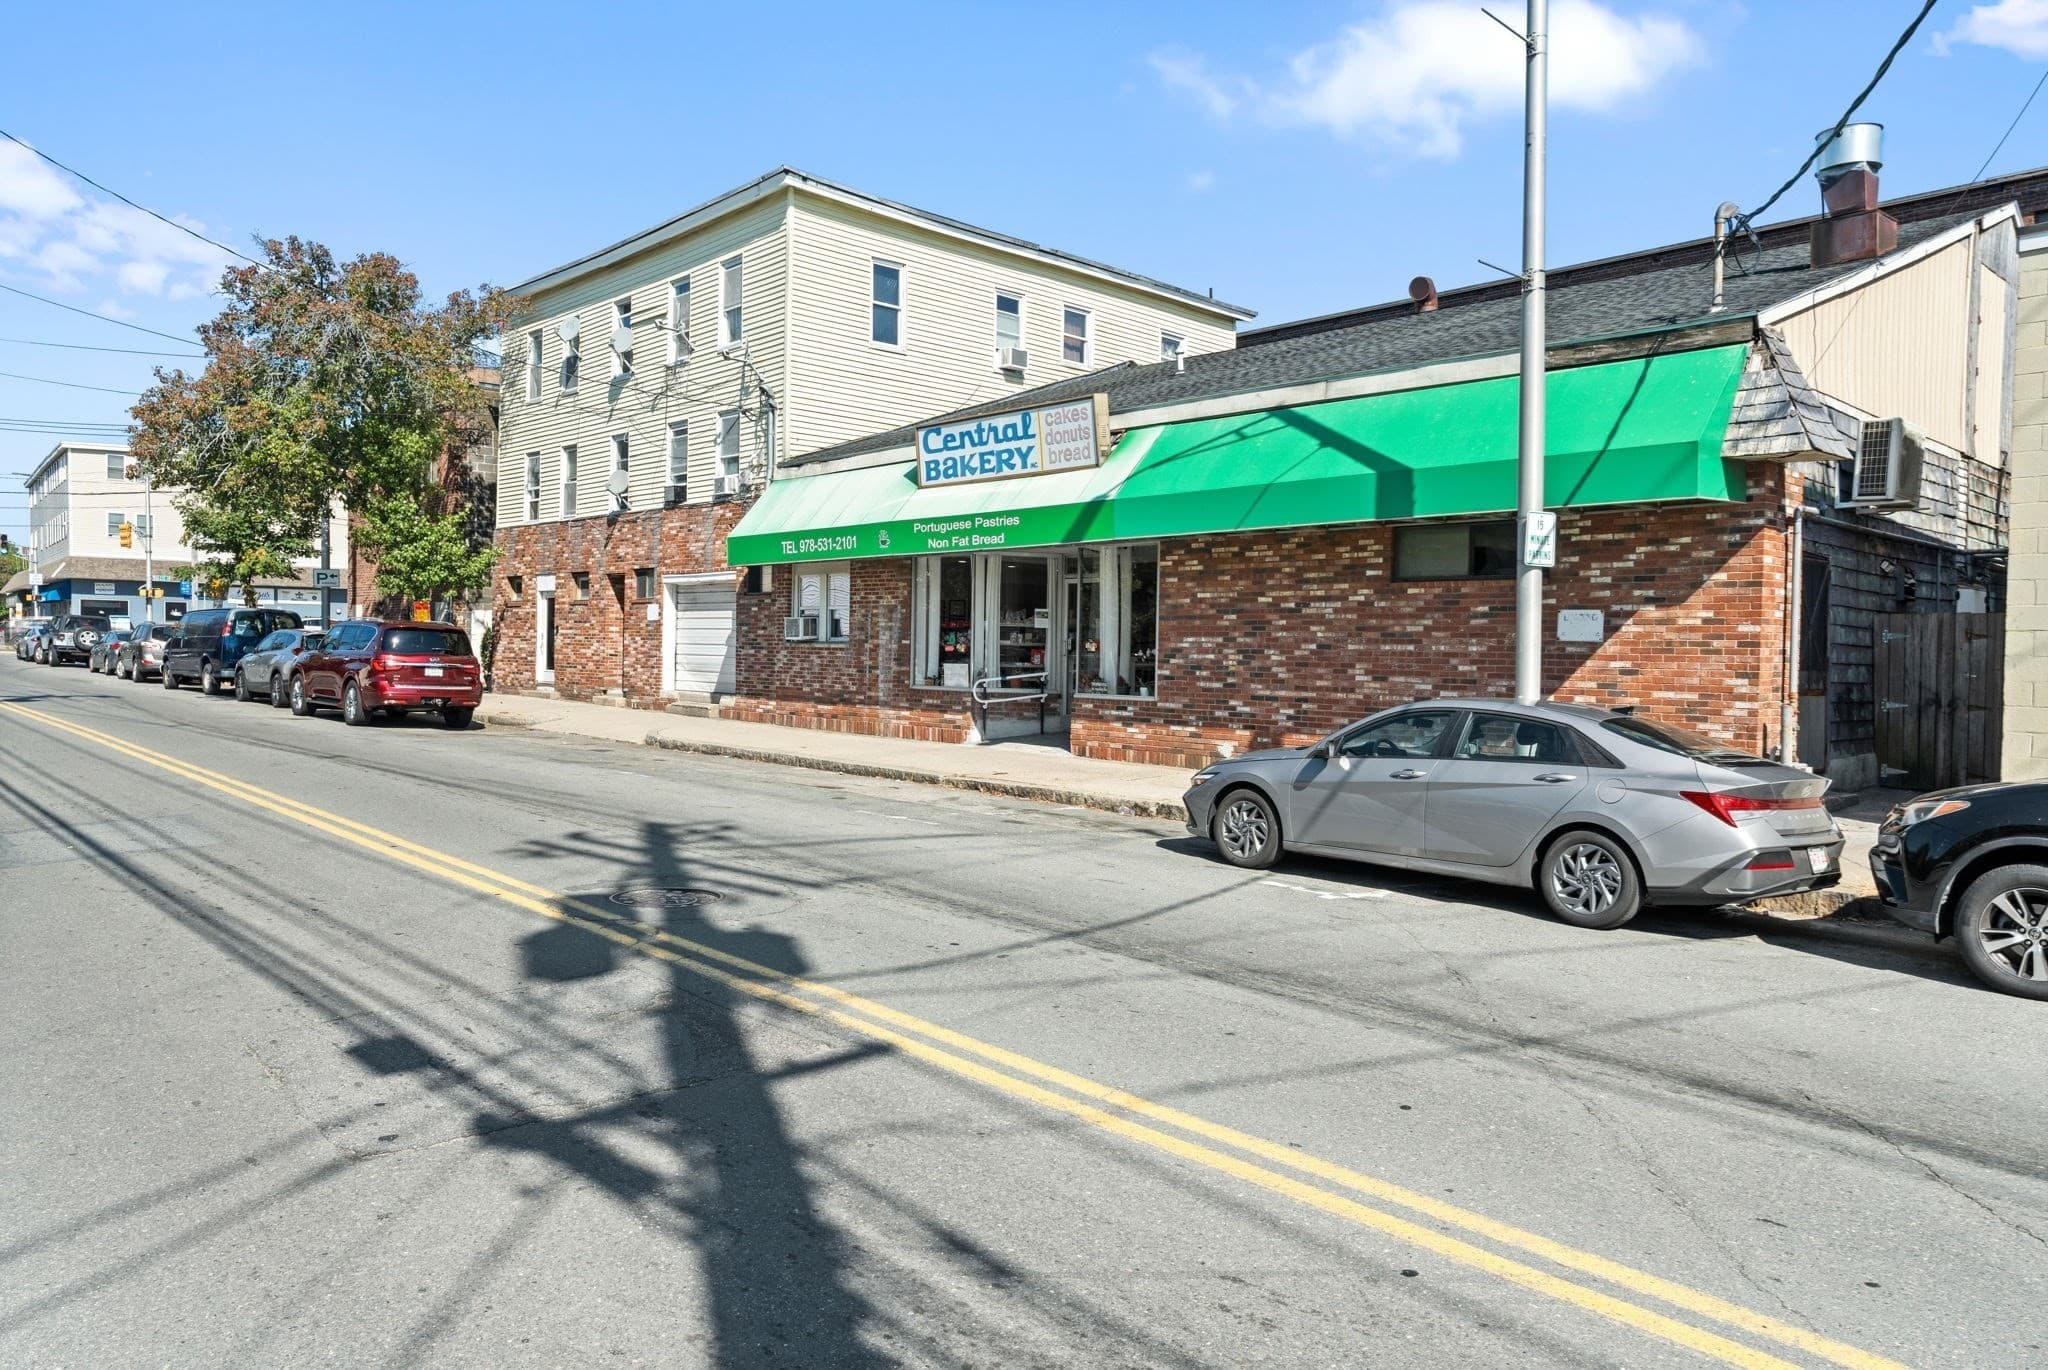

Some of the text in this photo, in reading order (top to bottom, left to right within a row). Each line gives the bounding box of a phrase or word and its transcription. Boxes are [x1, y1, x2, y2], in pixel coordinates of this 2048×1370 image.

[1044, 406, 1089, 427] cakes
[922, 411, 1037, 454] Central
[1045, 424, 1091, 446] donuts
[1048, 442, 1091, 465] bread
[913, 515, 1020, 534] Portuguese Pastries
[1537, 519, 1545, 530] 15
[781, 535, 857, 555] TEL 978-531-2101
[927, 532, 1005, 549] Non Fat Bread
[1530, 535, 1550, 545] MINUTE
[317, 572, 328, 584] P
